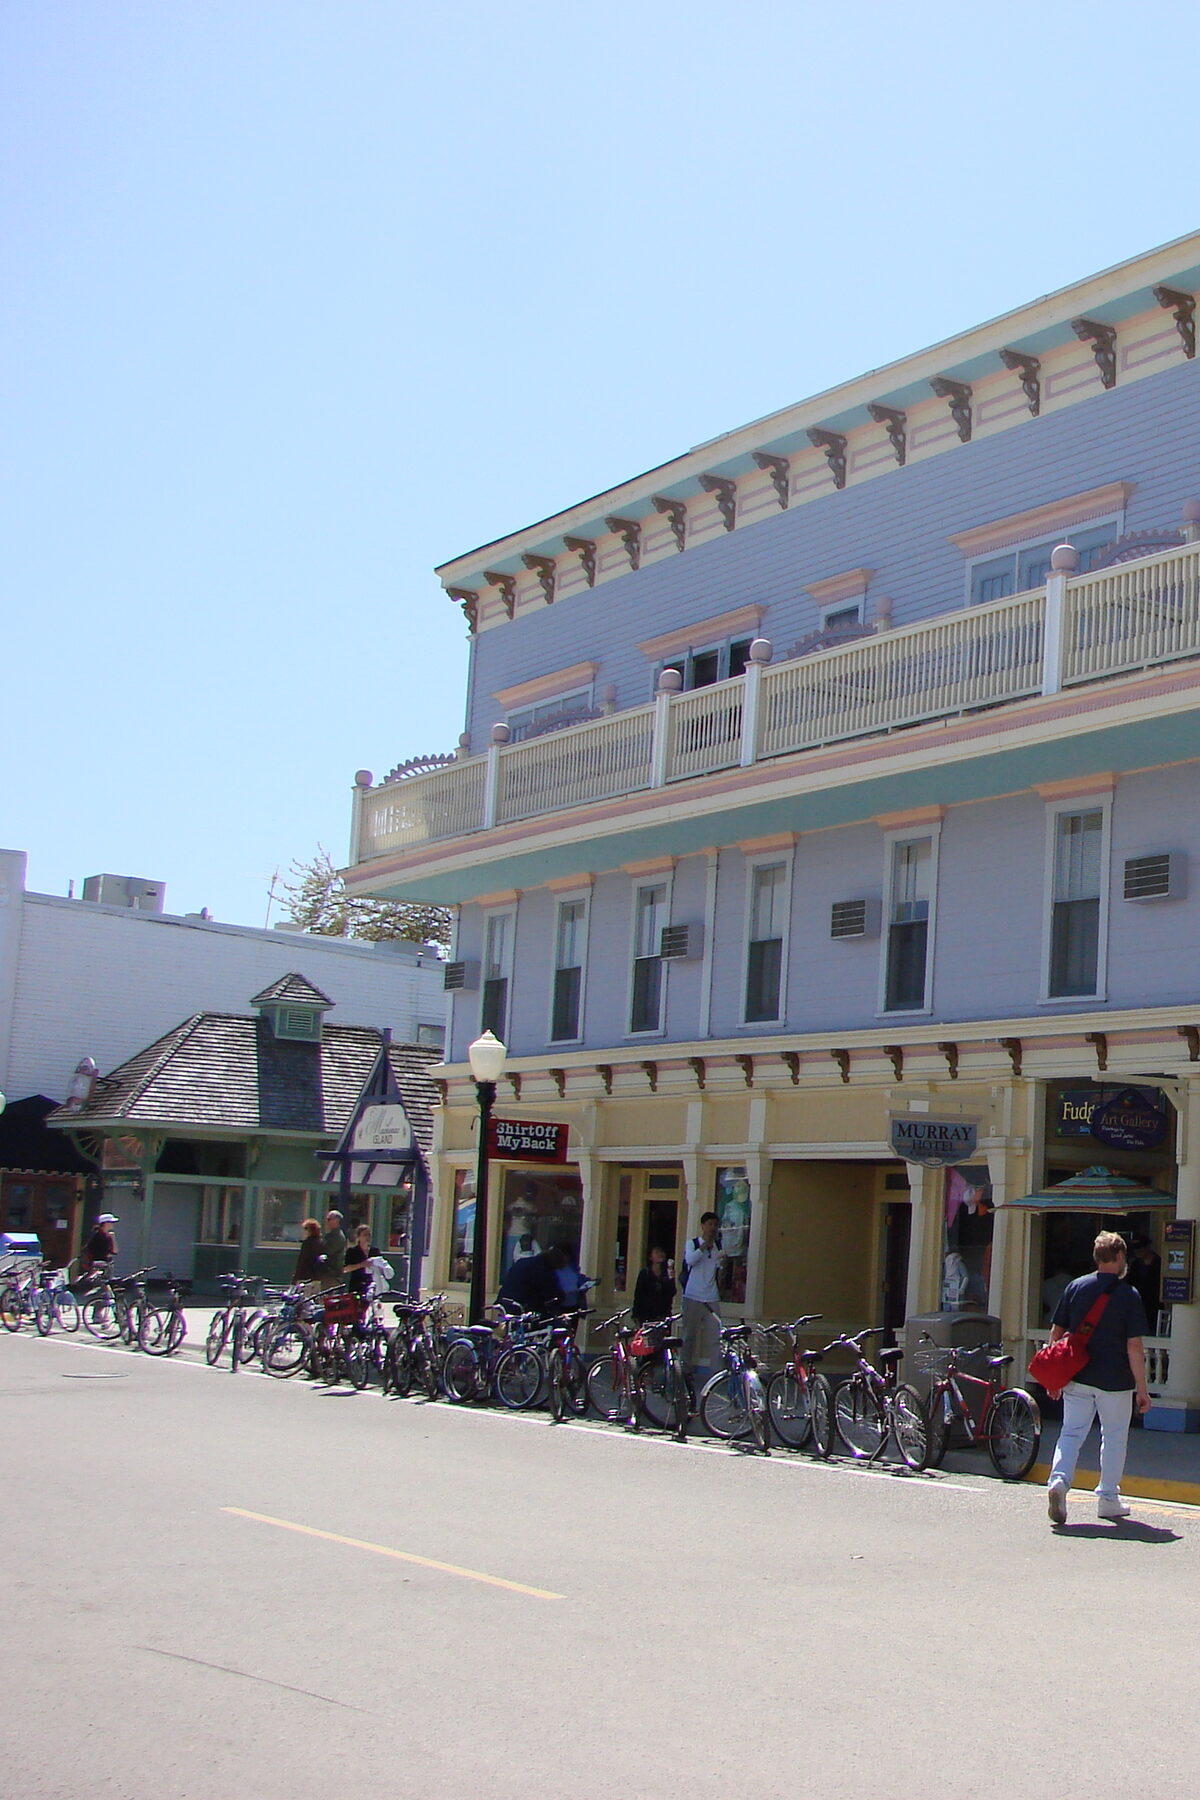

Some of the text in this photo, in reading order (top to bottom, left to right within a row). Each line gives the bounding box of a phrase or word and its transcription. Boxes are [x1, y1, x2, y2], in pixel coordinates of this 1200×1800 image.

[1062, 1101, 1100, 1125] Fudg
[1120, 1113, 1159, 1129] Gallery
[897, 1123, 972, 1141] MURRAY
